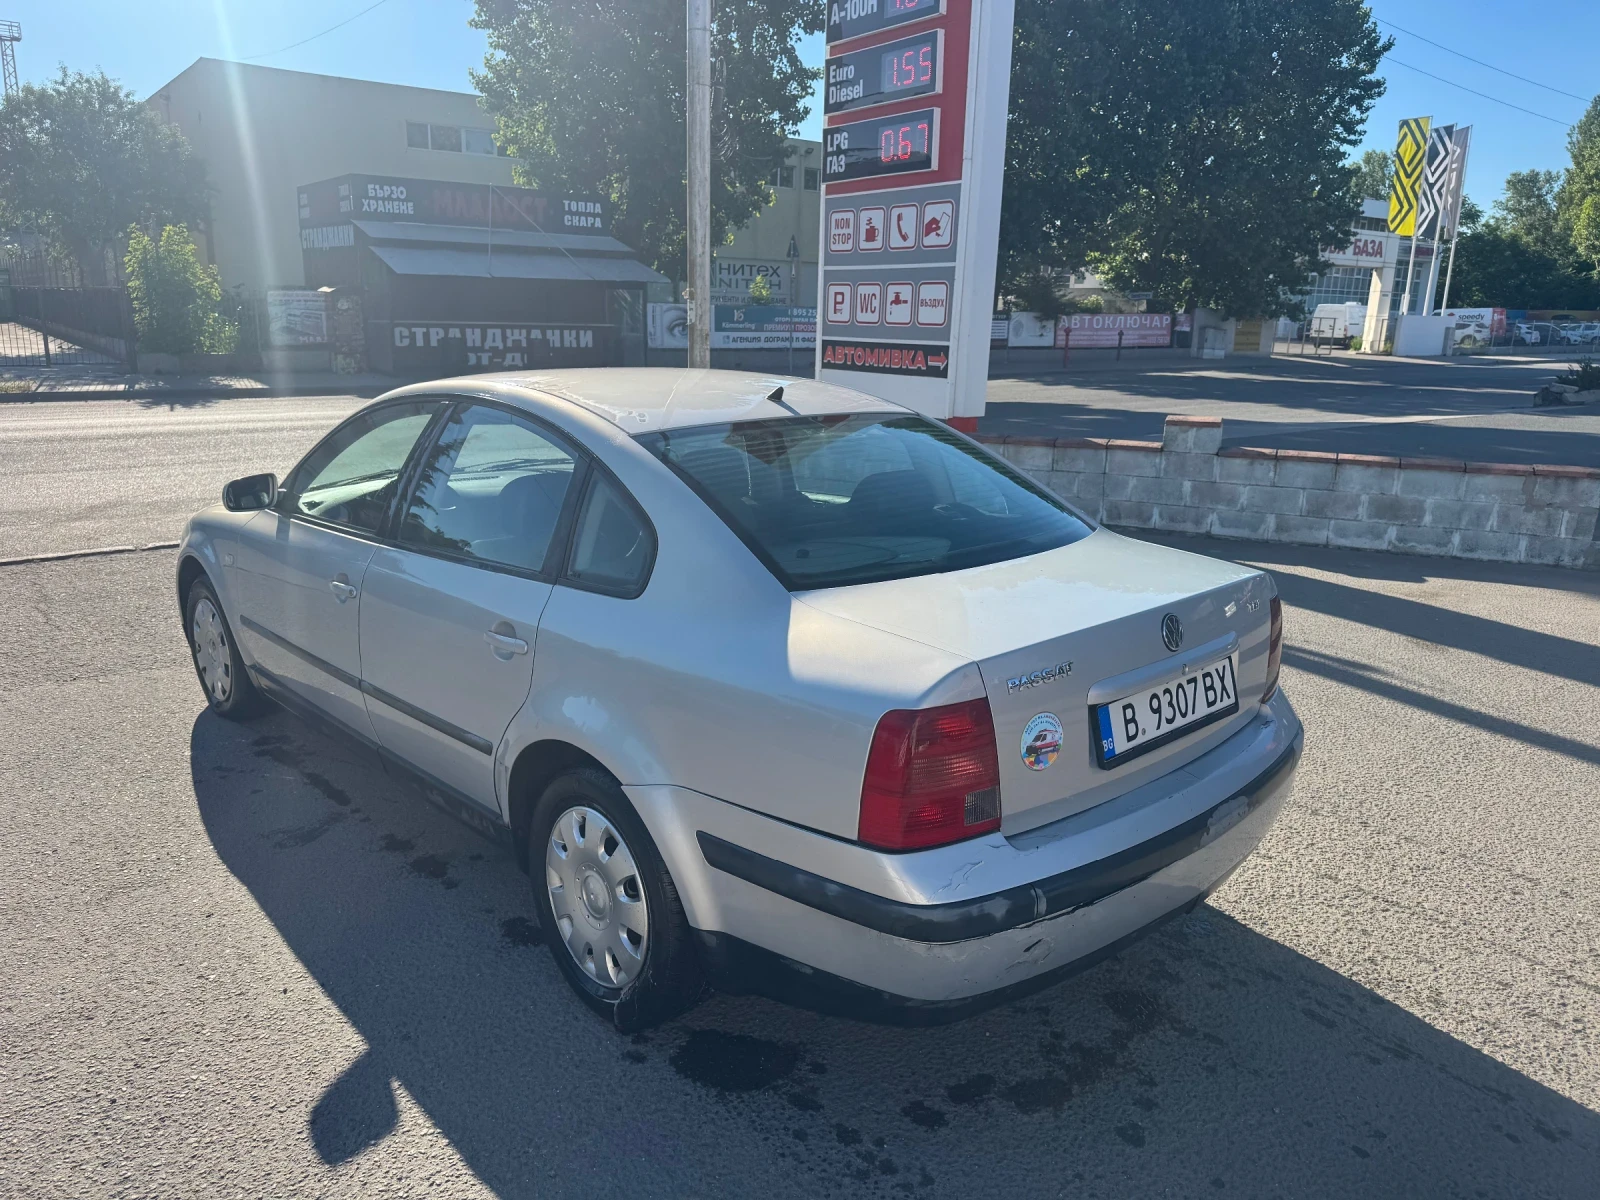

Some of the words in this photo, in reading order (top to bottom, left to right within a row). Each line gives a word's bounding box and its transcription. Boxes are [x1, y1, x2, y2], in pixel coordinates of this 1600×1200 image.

[829, 64, 855, 84] Euro
[829, 79, 863, 104] Diesel
[827, 131, 849, 153] LPG
[881, 123, 929, 163] 0.67
[826, 154, 846, 174] ГАЗ
[367, 183, 407, 199] БЪРЗО
[361, 198, 415, 215] ХРАНЕНЕ
[562, 200, 602, 214] ТОПЛА
[563, 214, 602, 228] СКАРА
[834, 217, 851, 230] NON
[301, 224, 355, 251] СТРАНДЖАНКИ
[832, 232, 852, 245] STOP
[1352, 238, 1383, 258] БАЗА
[719, 277, 782, 291] NITH
[860, 292, 877, 314] WC
[920, 298, 945, 309] ВЪЗДУХ
[1058, 315, 1171, 329] АВТОКЛЮЧАР
[1457, 313, 1486, 321] speedy
[731, 336, 761, 344] АГЕНЦИЯ
[823, 345, 927, 370] АВТОМИВКА
[1006, 660, 1073, 695] PASSAT
[1148, 676, 1198, 731] 9307
[1102, 737, 1114, 752] BG
